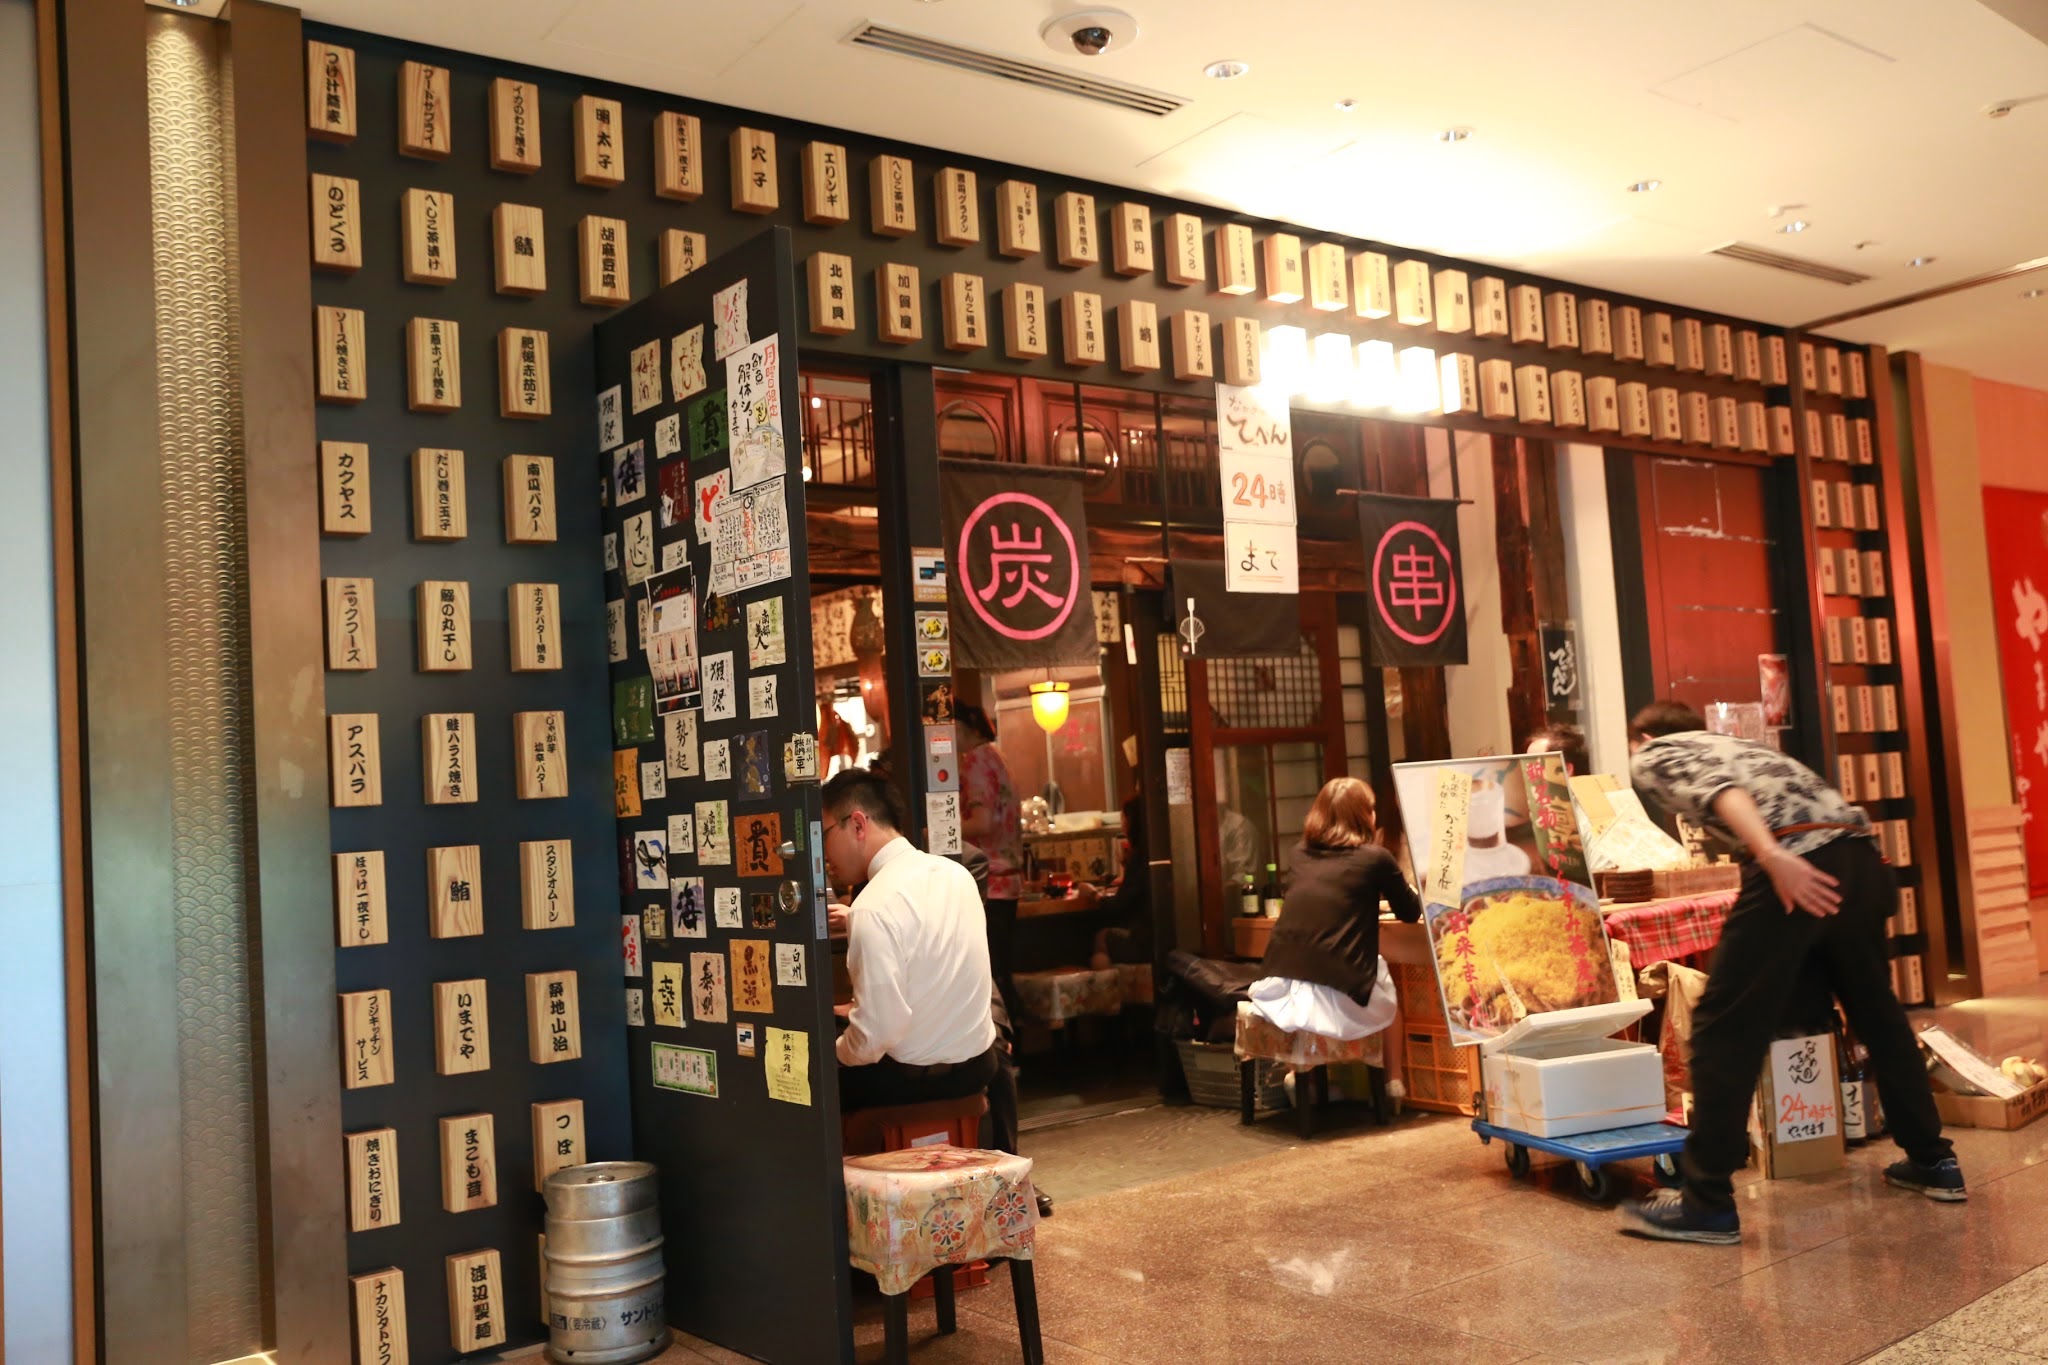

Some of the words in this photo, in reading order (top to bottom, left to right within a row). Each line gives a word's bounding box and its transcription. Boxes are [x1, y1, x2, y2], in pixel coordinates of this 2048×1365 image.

[595, 108, 613, 170] 明太子
[751, 146, 768, 188] 穴子
[823, 152, 839, 206] エリンギ
[328, 186, 347, 253] のどぐろ
[424, 194, 442, 271] へしこ茶漬け
[1184, 222, 1197, 271] のどぐろ
[600, 227, 617, 290] 胡麻豆腐
[829, 264, 845, 321] 北寄貝
[335, 311, 349, 391] ソース焼きそば
[764, 342, 779, 418] 月曜日限定
[338, 453, 356, 519] カクヤス
[436, 453, 452, 532] だし巻き玉子
[527, 462, 541, 533] 南瓜バター
[1231, 471, 1287, 510] 24時
[978, 523, 1066, 610] 炭
[1388, 544, 1445, 622] 串
[344, 584, 361, 663] ニックフーズ
[533, 587, 546, 664] ホタテバター焼き
[710, 659, 728, 713] 獺祭
[763, 680, 775, 711] 白州
[347, 725, 366, 795] アスパラ
[446, 718, 463, 797] 鮭ハラス焼き
[545, 716, 557, 753] じゃが芋
[718, 744, 728, 774] 白州
[653, 765, 663, 793] 白州
[945, 794, 956, 820] 白州
[681, 819, 690, 849] 白州
[748, 819, 770, 872] 貴
[947, 825, 958, 851] 白州
[355, 856, 371, 940] ほっけ一夜干し
[450, 881, 471, 903] 鮪
[545, 844, 559, 922] スタジオムーン
[729, 893, 739, 922] 白州
[792, 948, 802, 981] 白州
[367, 994, 381, 1056] フジキッチン
[457, 993, 475, 1059] いまでや
[549, 982, 569, 1053] 築地山治
[356, 1038, 370, 1081] サービス
[464, 1128, 482, 1199] まこも茸
[556, 1114, 574, 1171] つぼ
[366, 1138, 383, 1223] 焼きおにぎり
